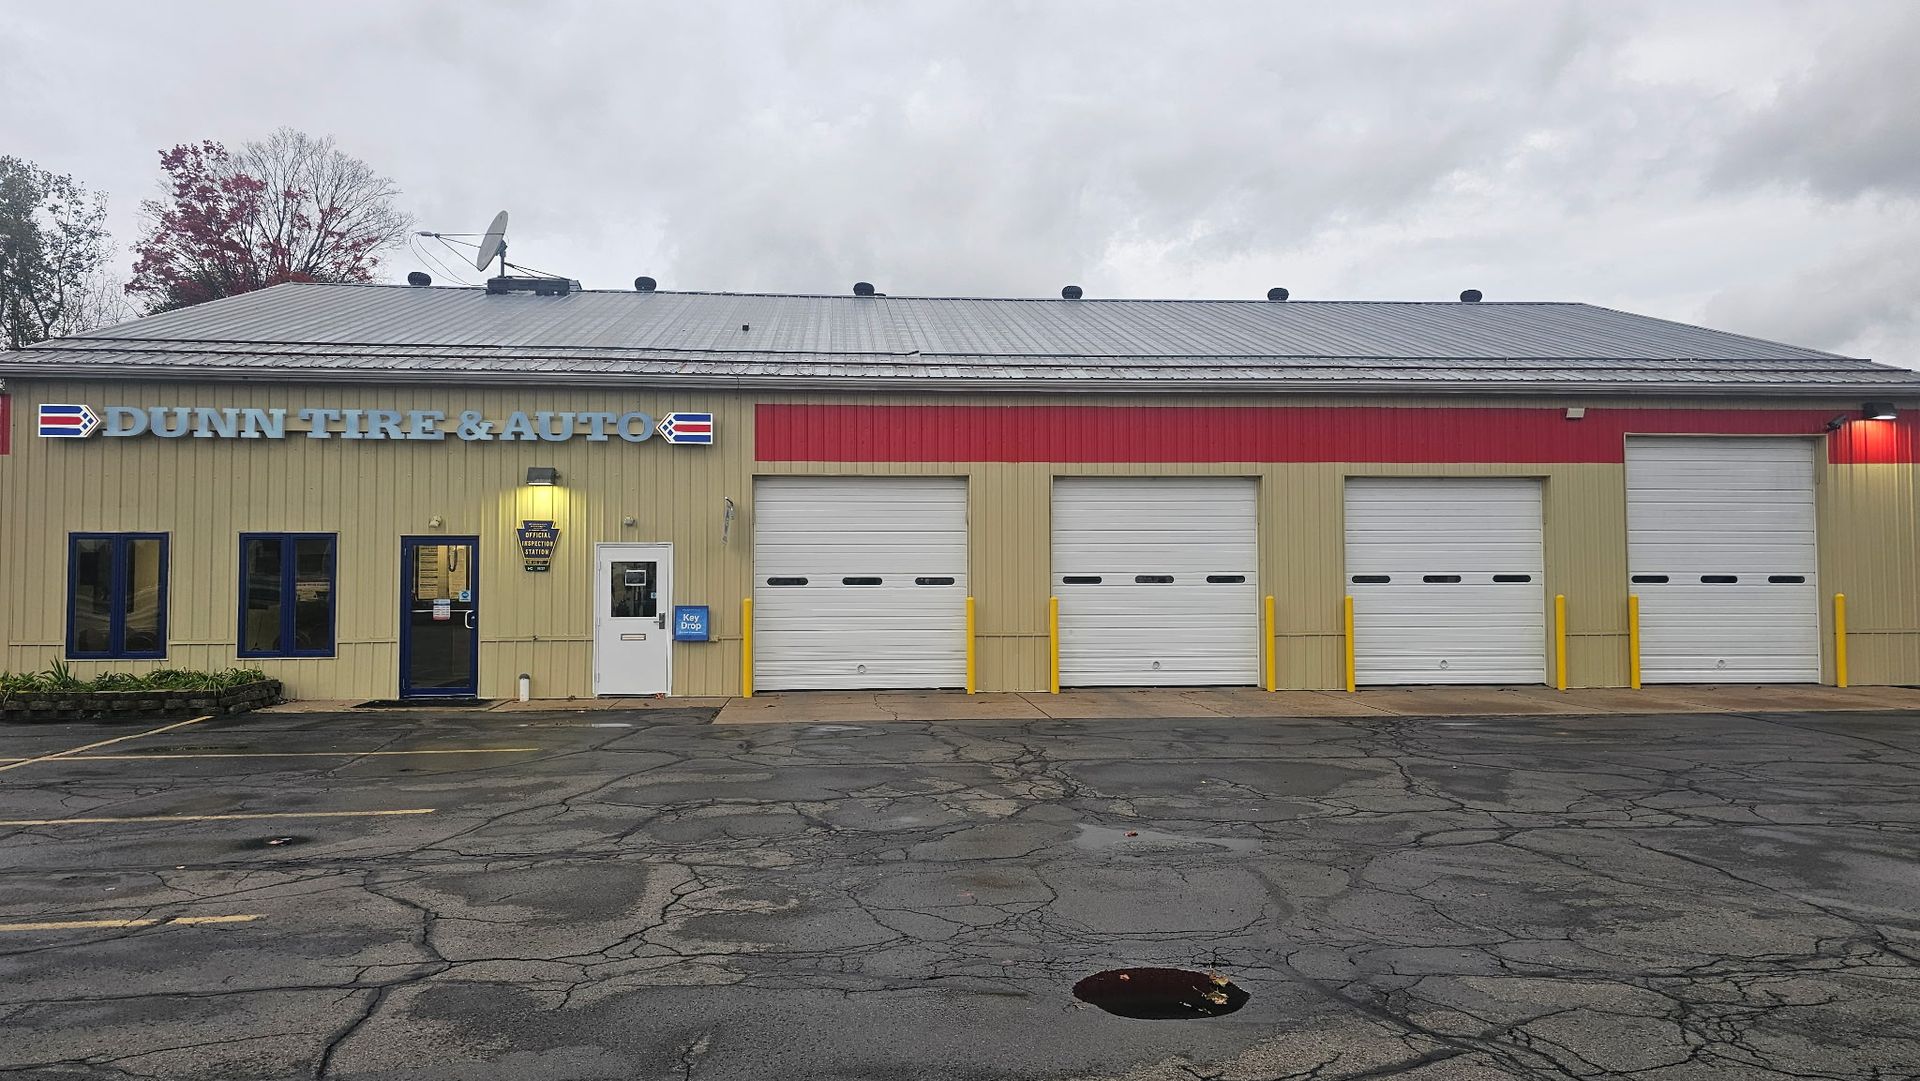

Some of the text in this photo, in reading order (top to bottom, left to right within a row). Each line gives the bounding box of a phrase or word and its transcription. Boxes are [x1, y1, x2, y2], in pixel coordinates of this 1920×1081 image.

[103, 405, 655, 443] DUNN TIRE & AUTO
[683, 613, 700, 623] Key
[681, 621, 702, 631] Drop
